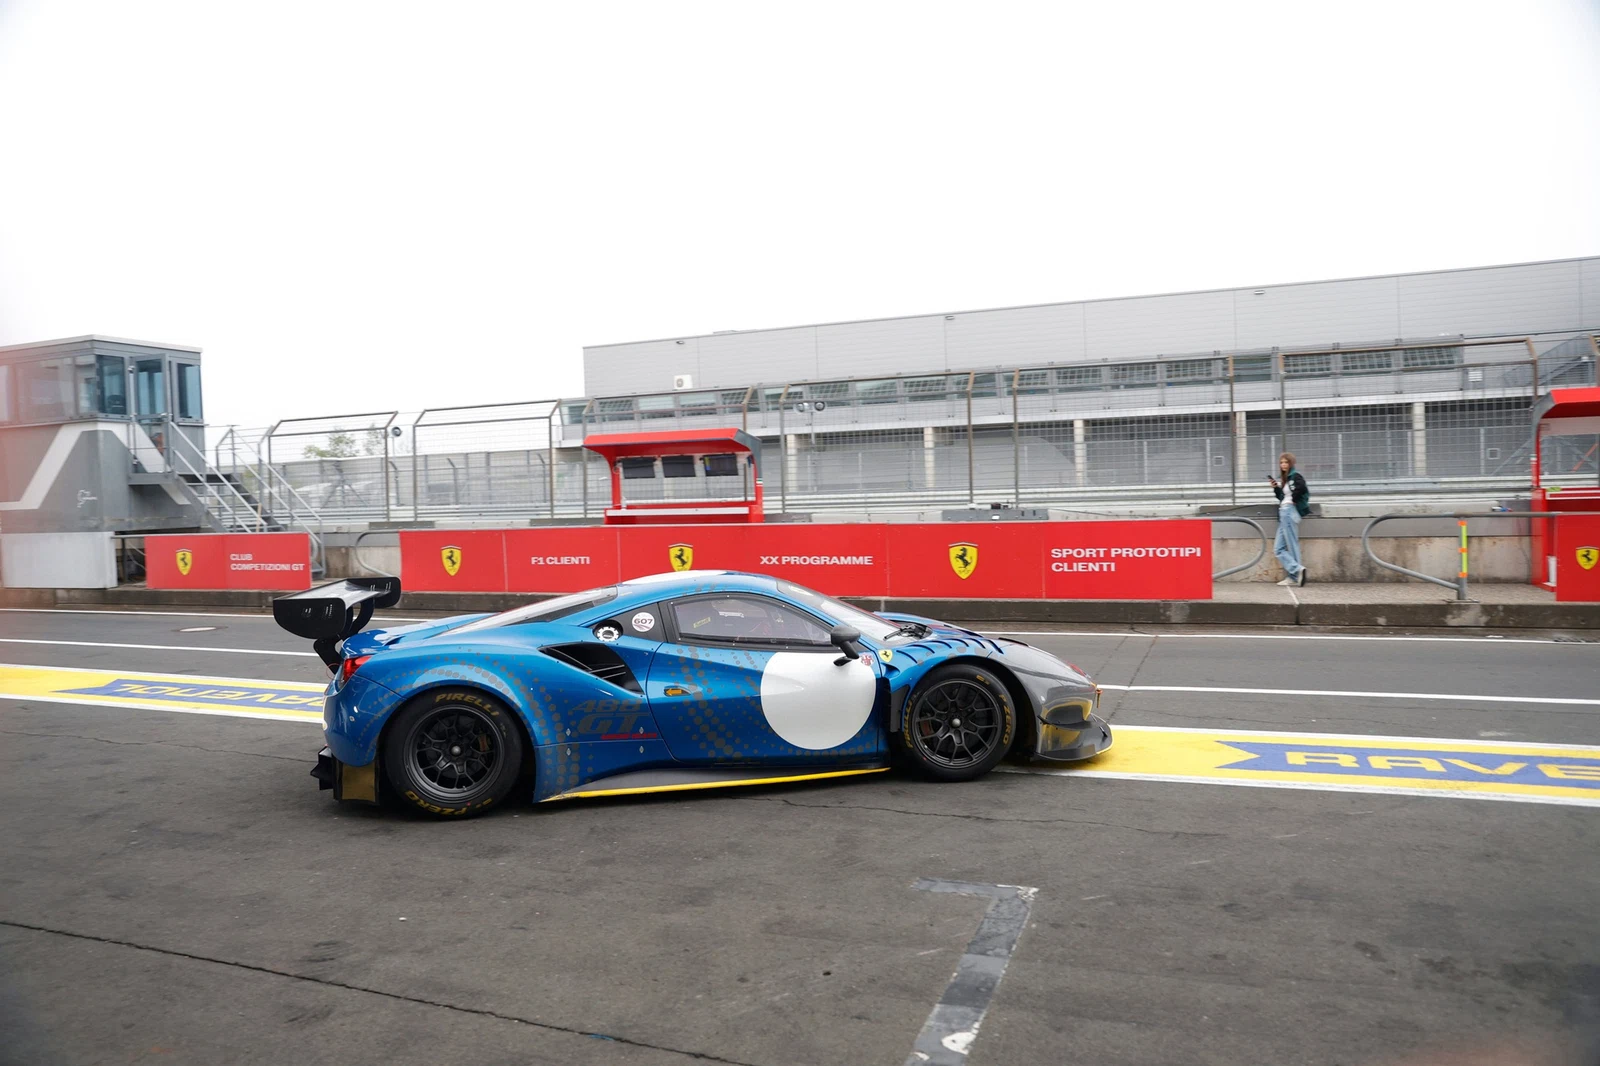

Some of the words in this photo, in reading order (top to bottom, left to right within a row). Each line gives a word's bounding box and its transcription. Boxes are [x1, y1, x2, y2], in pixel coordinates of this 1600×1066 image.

[230, 553, 253, 561] CLUB
[1051, 547, 1107, 558] SPORT
[1110, 547, 1201, 557] PROTOTIPI
[531, 556, 545, 565] F1
[545, 556, 590, 565] CLIENTI
[760, 556, 779, 565] XX
[781, 556, 873, 565] PROGRAMME
[230, 563, 291, 571] COMPETIZIONI
[291, 563, 305, 571] GT
[1051, 562, 1116, 572] CLIENTI
[435, 693, 500, 716] PIRELLI
[572, 698, 643, 713] 488
[577, 712, 650, 734] GT
